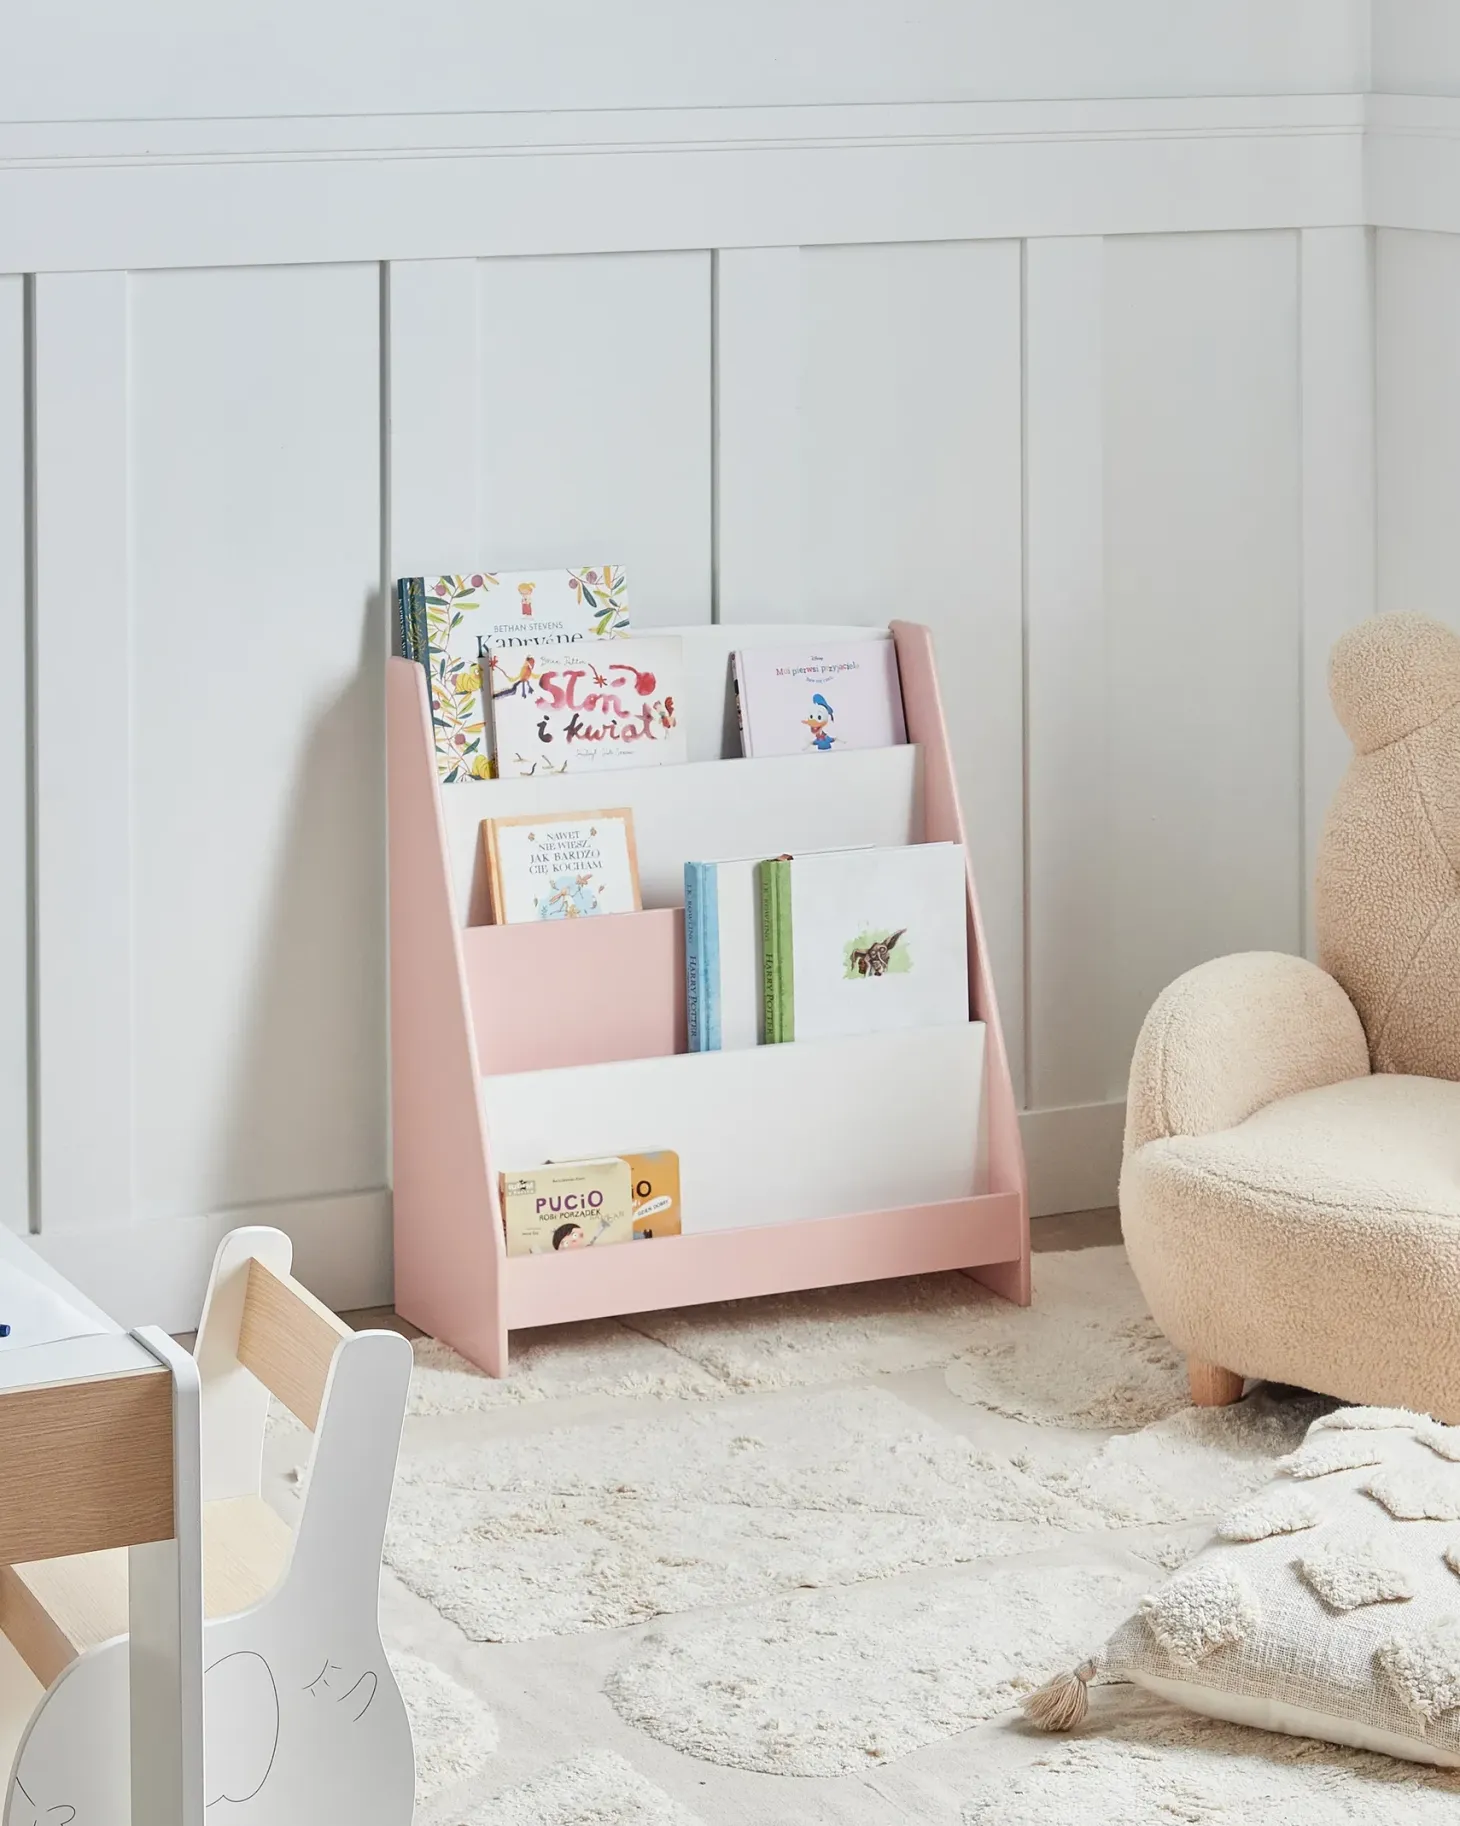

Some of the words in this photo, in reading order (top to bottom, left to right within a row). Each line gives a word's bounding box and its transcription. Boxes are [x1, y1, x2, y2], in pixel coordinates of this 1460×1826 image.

[494, 623, 526, 633] BETHAN
[529, 621, 563, 631] STEVENS
[537, 715, 553, 743] i
[563, 702, 657, 744] kwiat
[538, 842, 556, 851] NIE
[547, 830, 580, 840] NAWET
[530, 853, 550, 864] JAK
[554, 848, 601, 861] BARDZO
[552, 860, 604, 873] KOCHAM
[689, 955, 697, 995] HARRY
[765, 953, 774, 993] HARRY
[689, 996, 698, 1037] POTTER
[766, 994, 775, 1036] POTTER
